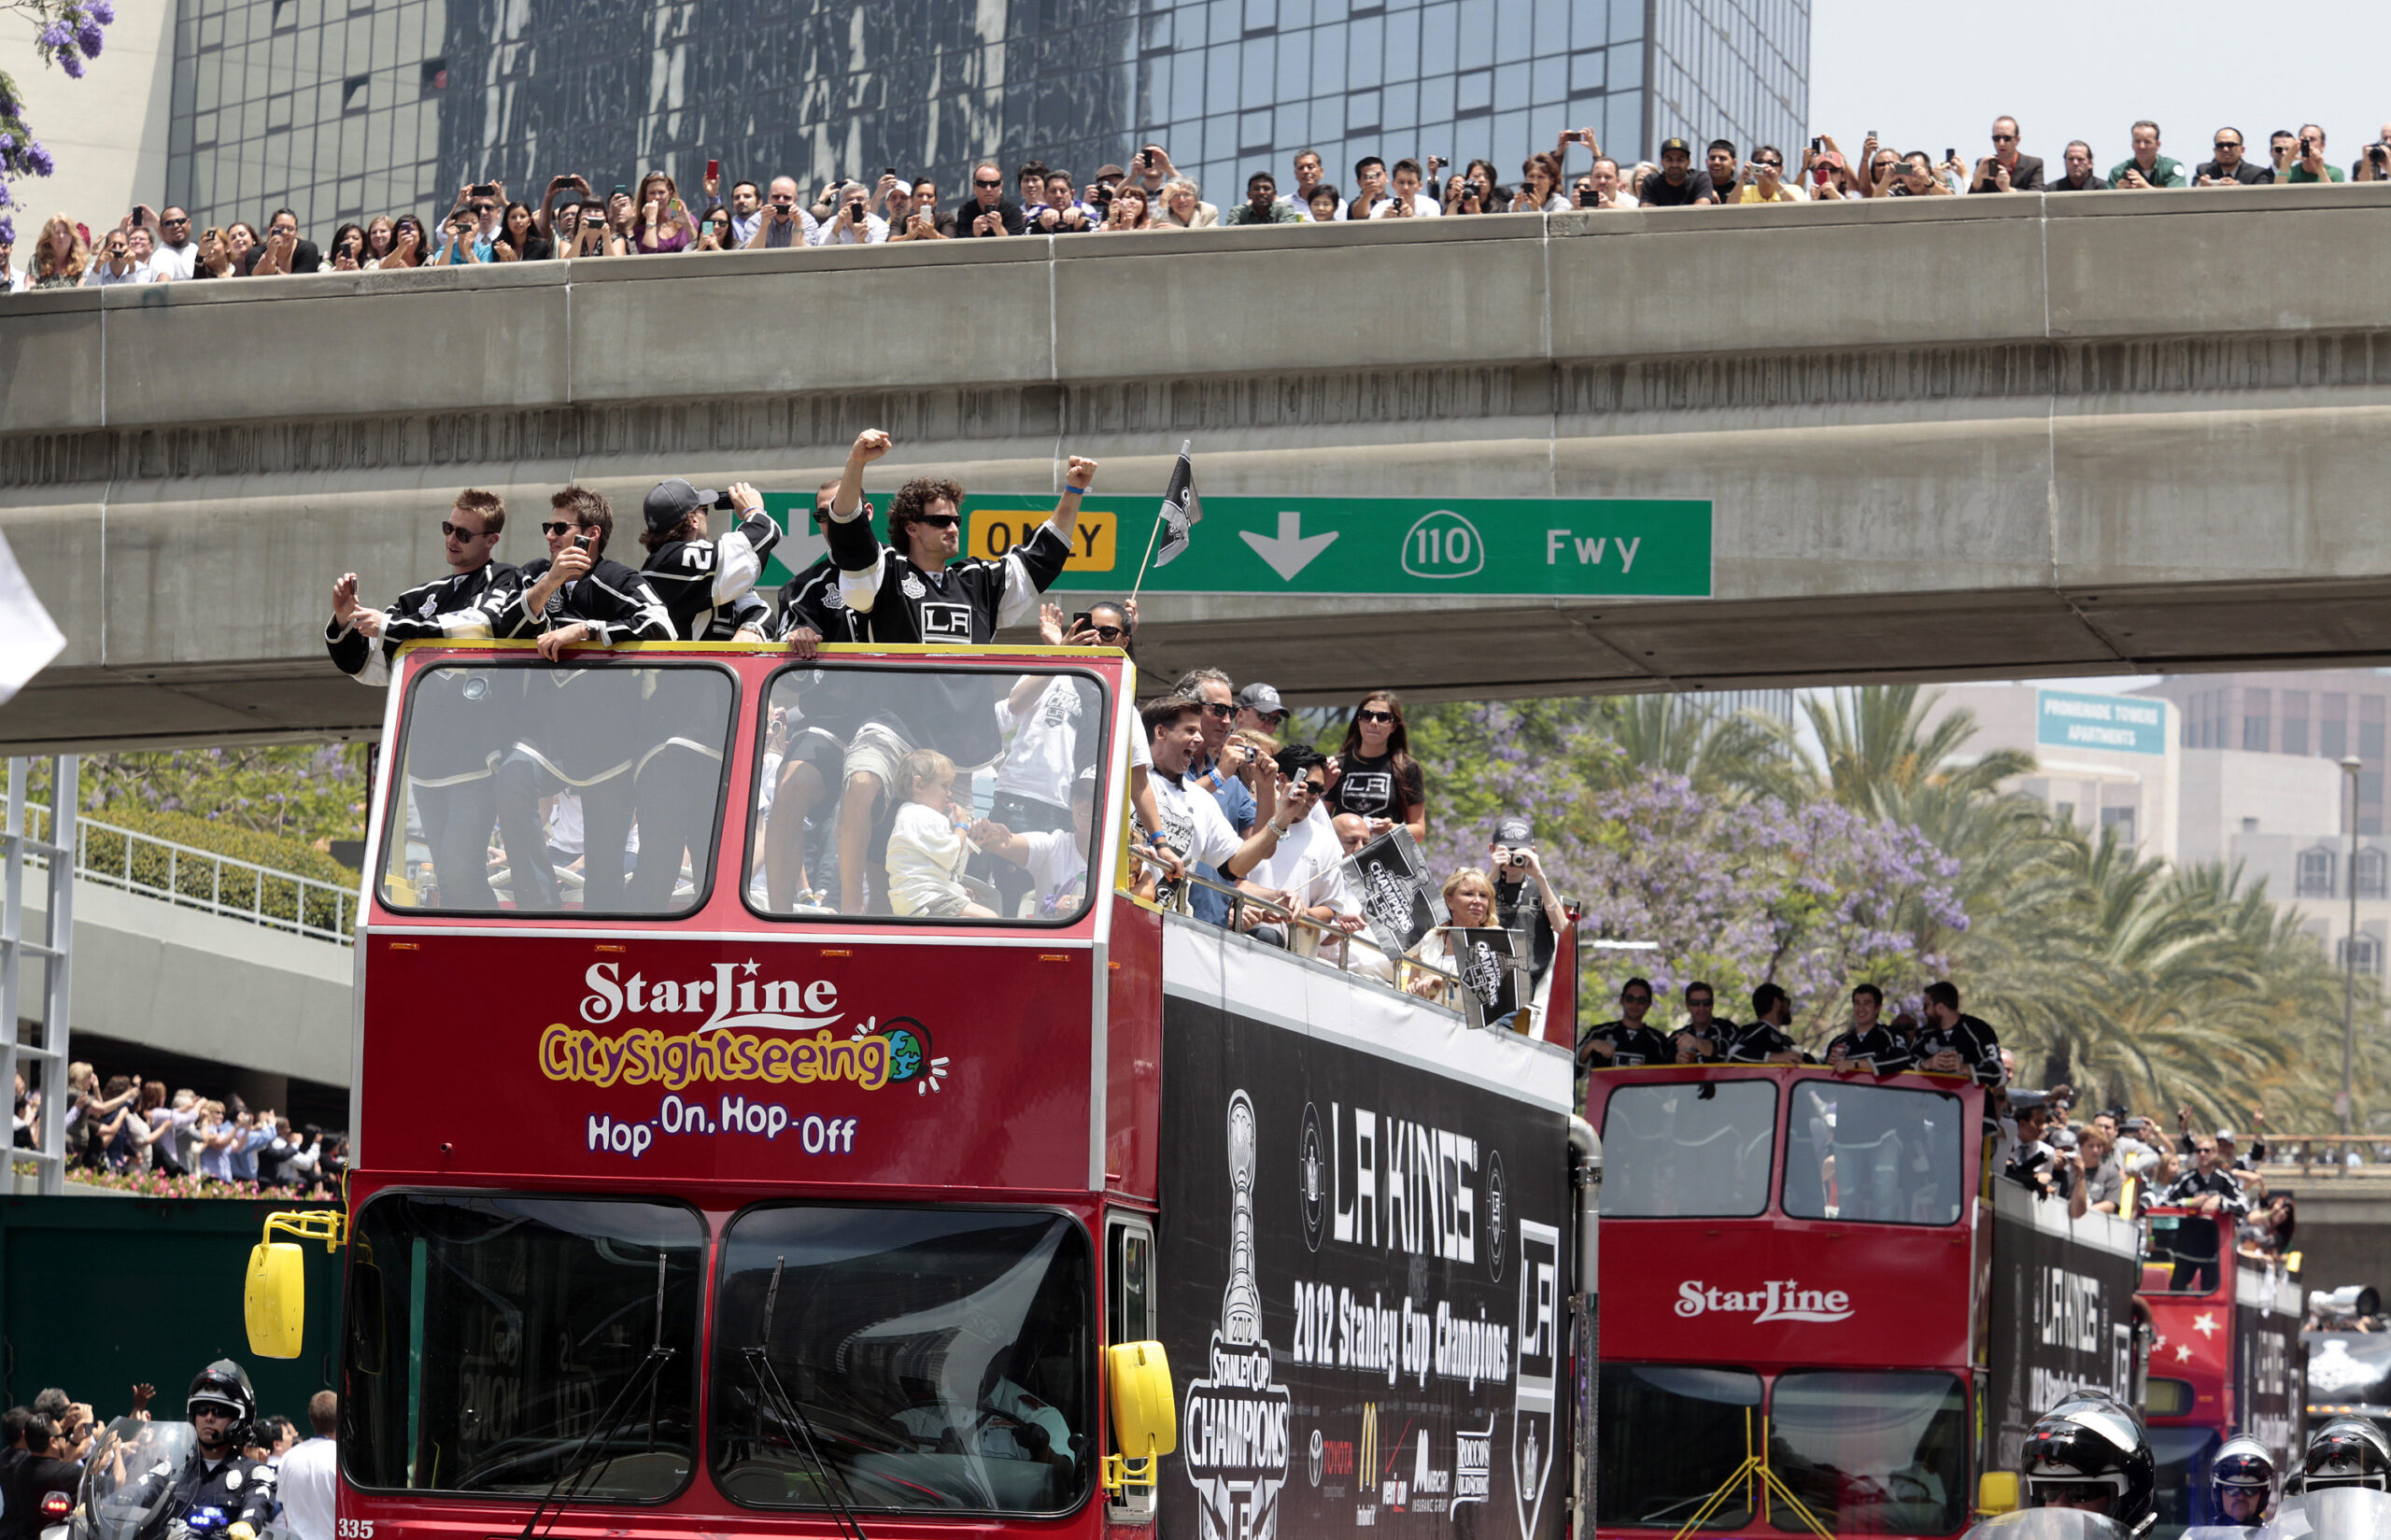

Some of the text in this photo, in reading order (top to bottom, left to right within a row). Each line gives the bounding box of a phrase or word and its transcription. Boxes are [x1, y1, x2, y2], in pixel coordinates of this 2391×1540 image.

[987, 522, 1102, 558] OY
[1416, 527, 1641, 574] 110 Fwy
[926, 610, 969, 633] LA
[2067, 724, 2136, 746] APARTMENTS
[2115, 704, 2158, 726] TOWERS
[1346, 778, 1386, 792] LA
[1370, 861, 1413, 933] CHAMPIONS
[579, 957, 845, 1034] StarLine
[1478, 941, 1498, 1007] CHAMPIONS
[1332, 1102, 1475, 1264] LA KINGS
[1521, 1260, 1554, 1357] LA
[1674, 1278, 1855, 1324] StarLine
[1232, 1316, 1252, 1343] 2012
[1294, 1280, 1509, 1395] 2012 Stanley Cup Champions
[1212, 1348, 1269, 1392] STANLEY CUP
[1187, 1396, 1288, 1469] CHAMPIONS
[1323, 1440, 1353, 1475] TOYOTA
[338, 1518, 375, 1539] 335
